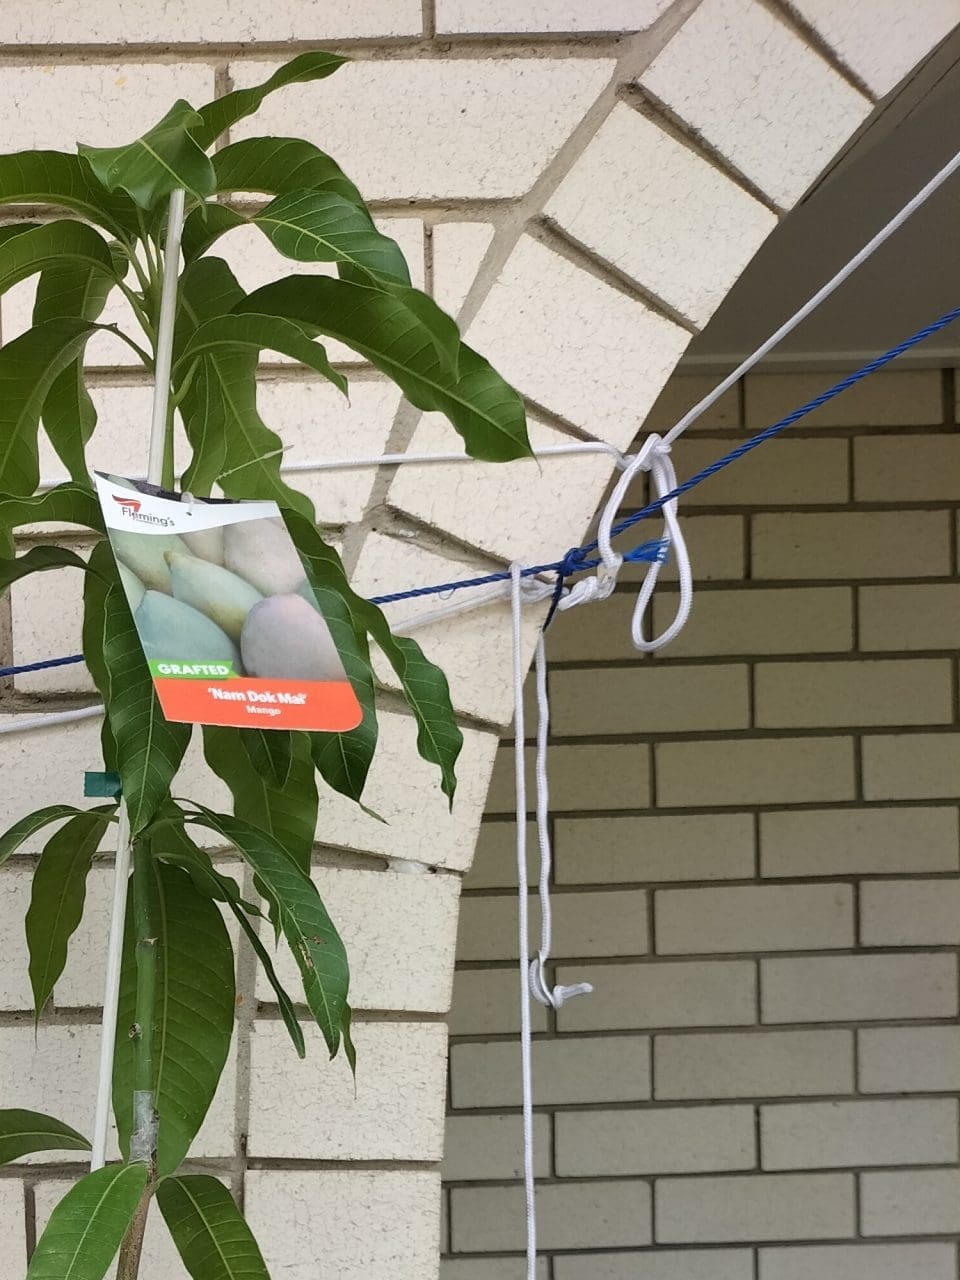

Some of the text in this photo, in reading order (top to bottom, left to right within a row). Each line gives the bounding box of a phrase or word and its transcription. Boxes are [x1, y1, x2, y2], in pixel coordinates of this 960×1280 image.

[122, 506, 175, 527] Fleming's
[157, 663, 230, 676] GRAFTED
[247, 690, 276, 703] Dok
[246, 705, 281, 716] Mango
